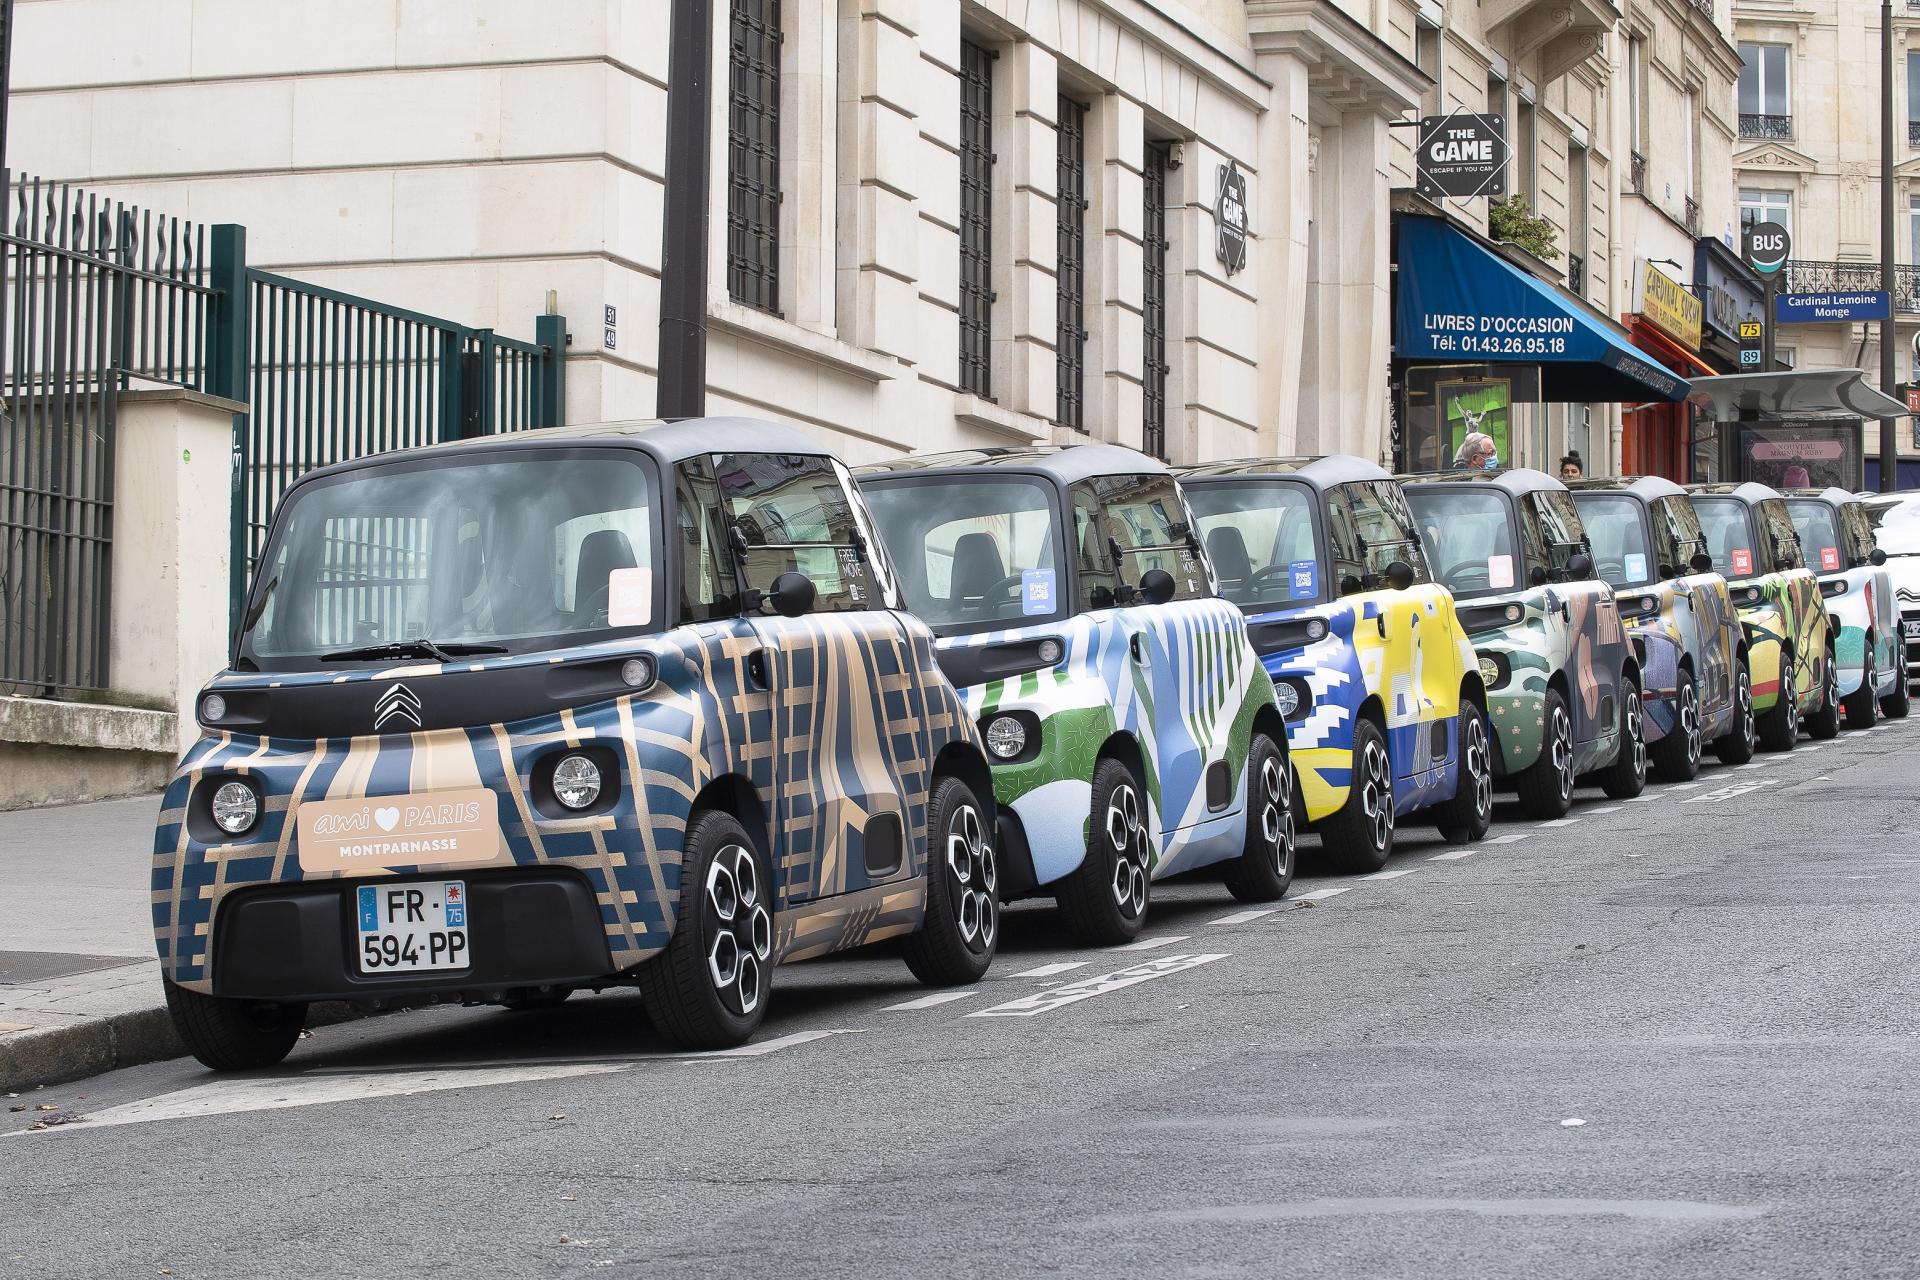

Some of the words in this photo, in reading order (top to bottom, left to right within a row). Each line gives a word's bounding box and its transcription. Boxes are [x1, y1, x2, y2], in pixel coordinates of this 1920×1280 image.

[1447, 129, 1475, 139] THE
[1430, 140, 1493, 162] GAME
[1222, 197, 1243, 229] GAME
[1753, 234, 1784, 251] BUS
[1647, 269, 1678, 313] CARDINAL
[1681, 294, 1700, 328] SUSHI
[1788, 295, 1830, 306] Cardinal
[1833, 294, 1877, 305] Lemoine
[607, 307, 615, 323] 51
[1815, 308, 1850, 318] Monge
[1424, 314, 1475, 331] LIVRES
[1480, 316, 1573, 333] D'OCCASION
[1742, 325, 1758, 336] 75
[606, 330, 615, 346] 49
[1431, 334, 1456, 351] Tél:
[1461, 335, 1565, 353] 01.43.26.95.18
[1743, 351, 1758, 363] 89
[313, 806, 370, 834] ami
[404, 801, 481, 828] PARIS
[340, 838, 458, 858] MONTPARNASSE
[365, 913, 372, 924] F
[448, 908, 462, 923] 75
